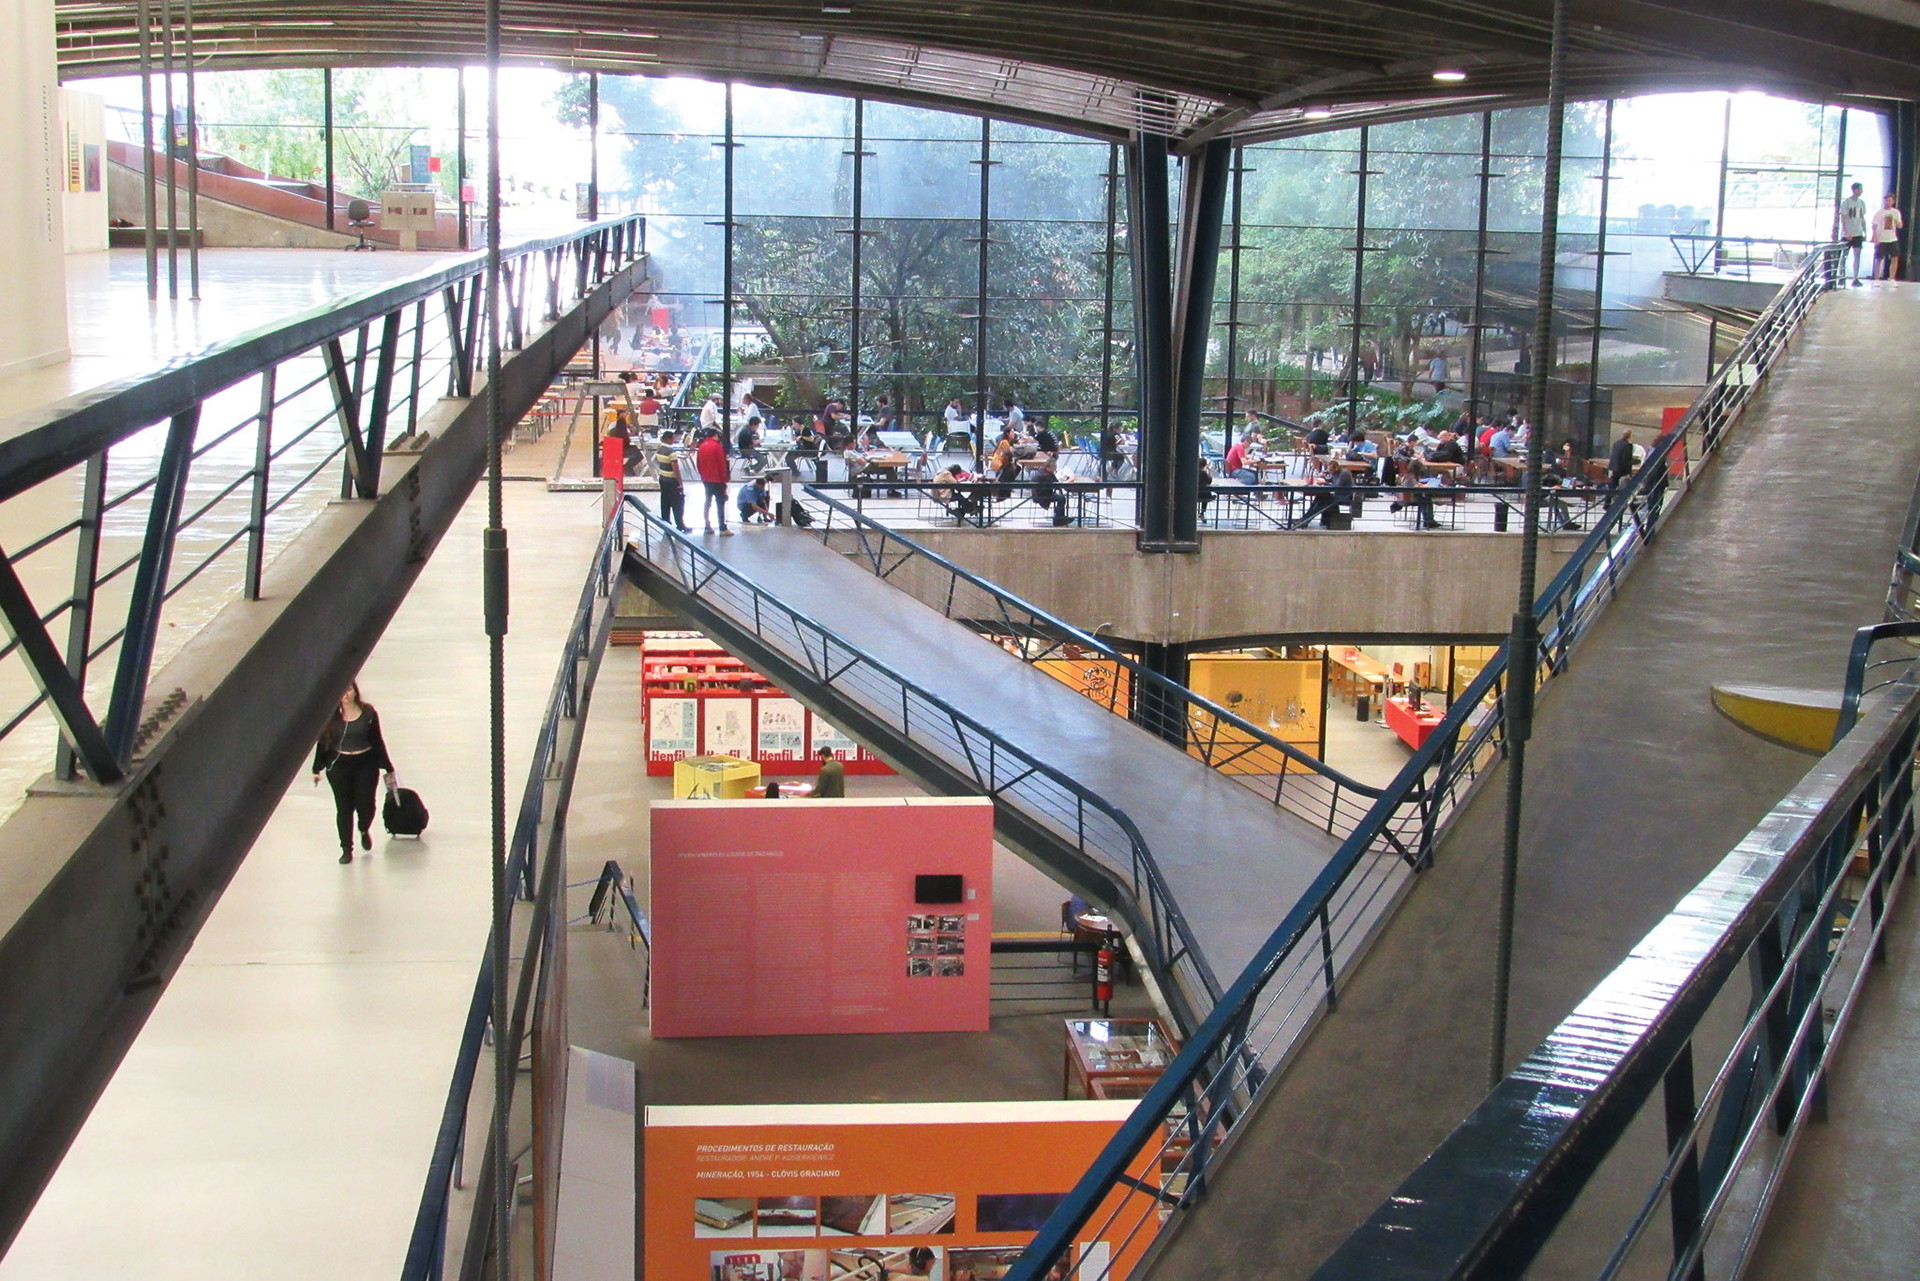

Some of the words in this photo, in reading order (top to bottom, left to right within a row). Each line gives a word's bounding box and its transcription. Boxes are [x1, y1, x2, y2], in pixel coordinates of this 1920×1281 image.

[652, 749, 685, 761] Henfil
[759, 749, 793, 761] Henfil
[812, 749, 846, 761] Hfil
[696, 1144, 763, 1152] PROCEDIMENTOS
[765, 1144, 776, 1152] DE
[777, 1142, 835, 1152] RESTAURAÇÃO
[696, 1170, 745, 1179] MINERAÇÃO,
[747, 1170, 765, 1178] 1954
[771, 1168, 799, 1178] CLÓVIS
[800, 1169, 840, 1178] GRACIANO
